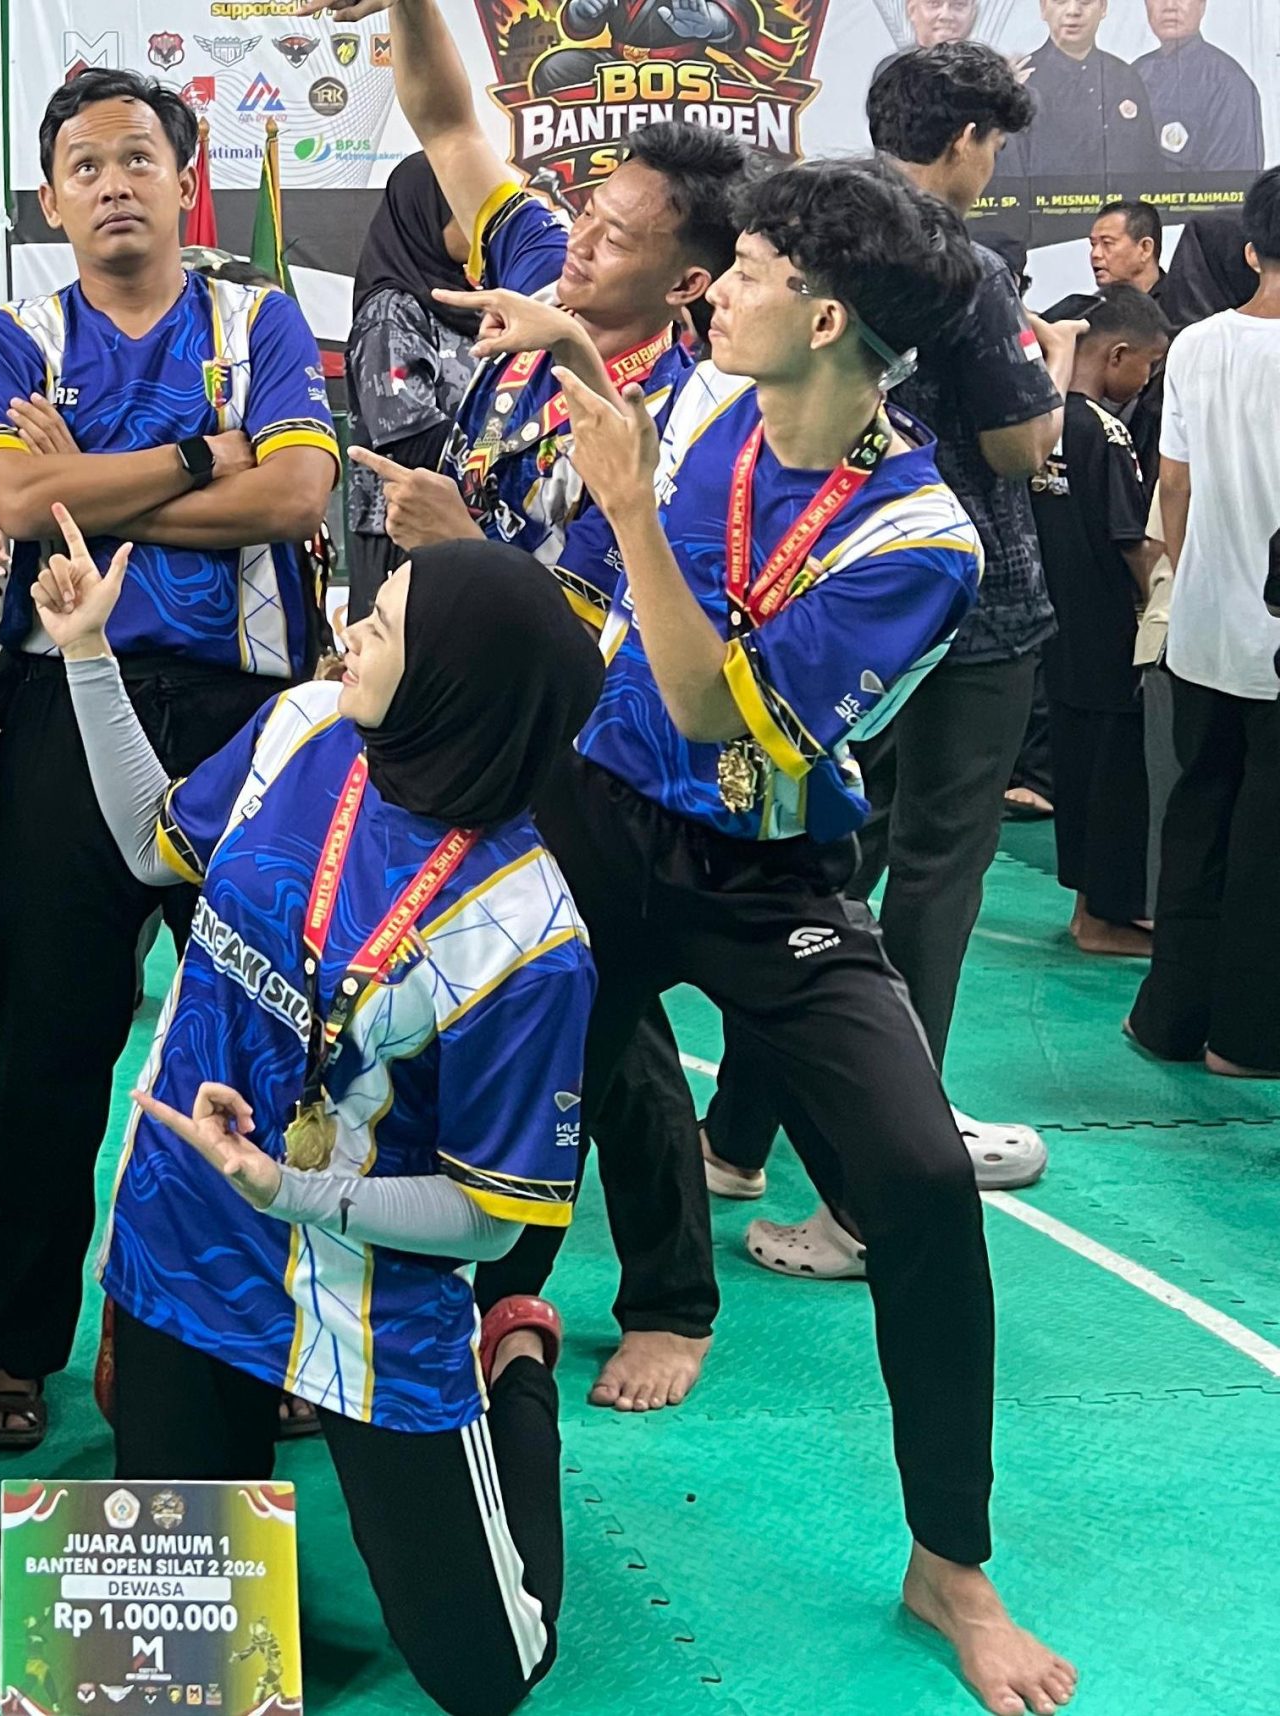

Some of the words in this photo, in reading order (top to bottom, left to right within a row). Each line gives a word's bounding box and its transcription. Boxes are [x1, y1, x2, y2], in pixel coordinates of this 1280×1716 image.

[211, 2, 296, 20] supported
[602, 65, 715, 101] BOS
[521, 104, 674, 160] BANTEN
[683, 102, 792, 154] OPEN
[208, 144, 263, 159] atimah
[336, 140, 370, 150] BPJS
[1036, 196, 1049, 206] H.
[1051, 194, 1104, 206] MISNAN,
[1140, 193, 1187, 204] SLAMET
[1188, 191, 1245, 203] RAHMADI
[834, 700, 861, 726] 20
[409, 870, 441, 908] OPEN
[434, 833, 466, 872] SILAT
[556, 1133, 580, 1146] 20
[63, 1534, 136, 1554] JUARA
[141, 1535, 212, 1555] UMUM
[219, 1536, 230, 1555] 1
[25, 1557, 99, 1573] BANTEN
[102, 1558, 152, 1574] OPEN
[155, 1559, 205, 1575] SILAT
[207, 1561, 219, 1576] 2
[223, 1561, 267, 1577] 2026
[108, 1581, 184, 1597] DEWASA
[53, 1602, 93, 1637] Rp
[100, 1603, 238, 1632] 1.000.000
